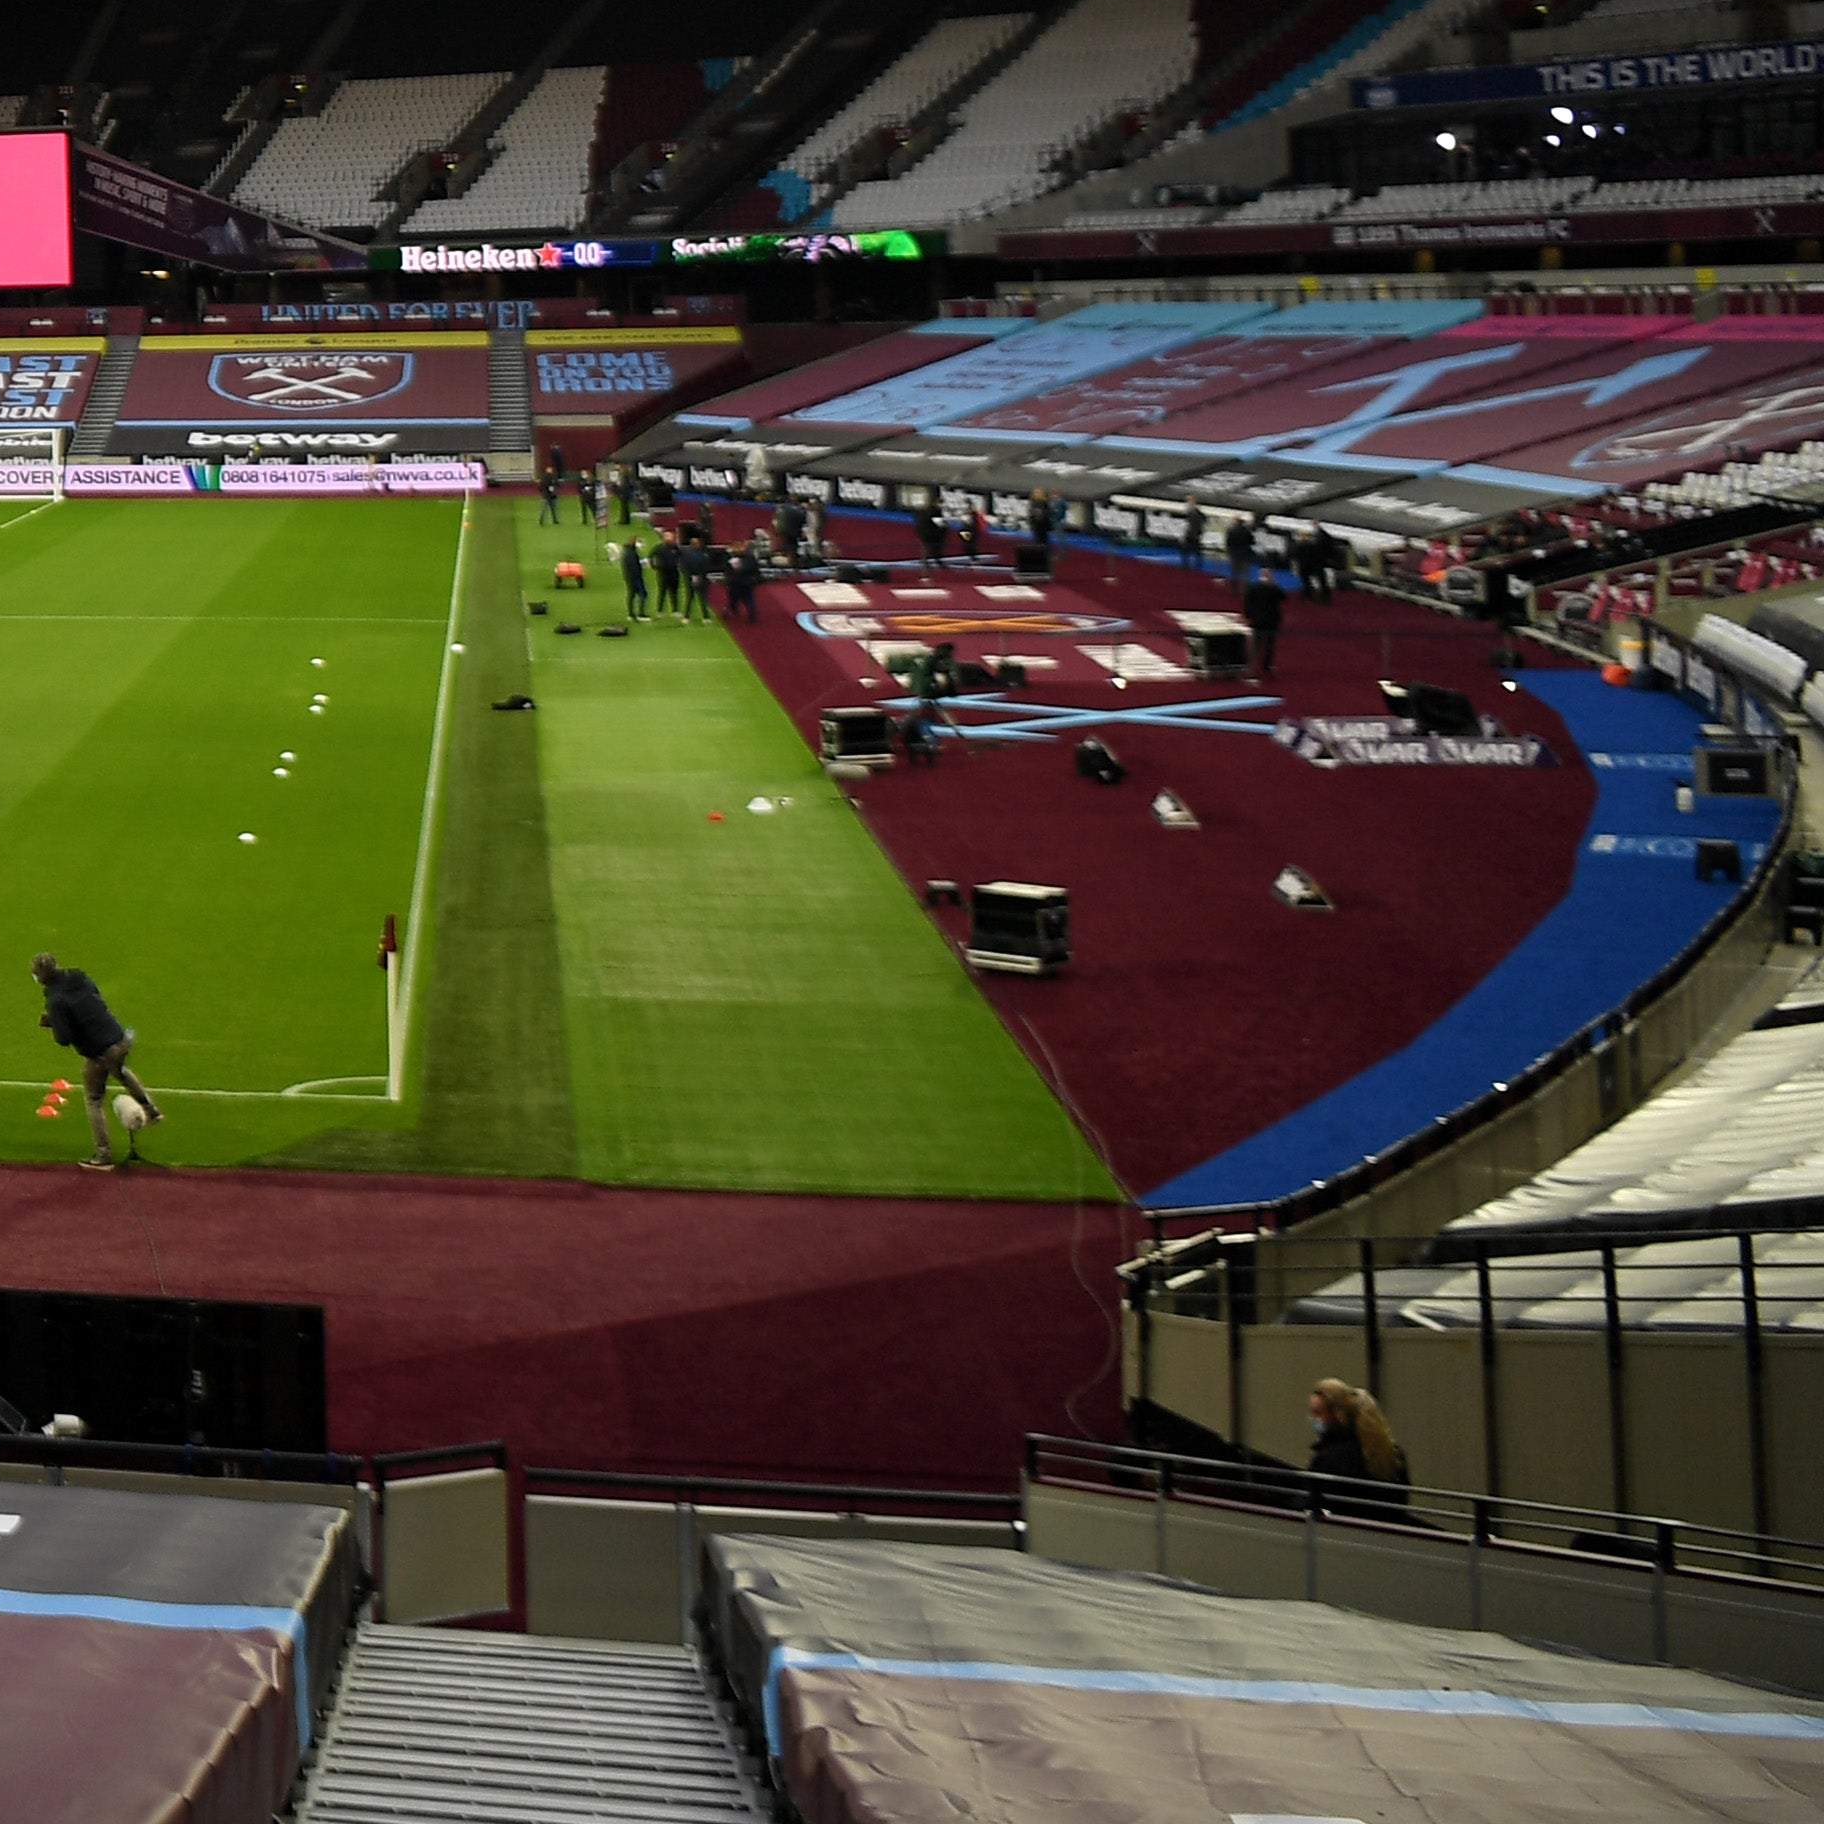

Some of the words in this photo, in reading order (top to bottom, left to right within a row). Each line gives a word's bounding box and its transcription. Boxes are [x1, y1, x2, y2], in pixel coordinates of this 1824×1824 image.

[1537, 63, 1607, 93] THIS
[1610, 59, 1640, 88] IS
[1643, 55, 1700, 85] THE
[400, 243, 538, 272] Heineken
[536, 351, 668, 367] COME
[187, 432, 402, 447] betway
[70, 470, 180, 485] ASSISTANCE
[221, 469, 326, 483] 08081641075
[786, 472, 832, 503] betway
[838, 476, 885, 508] betway
